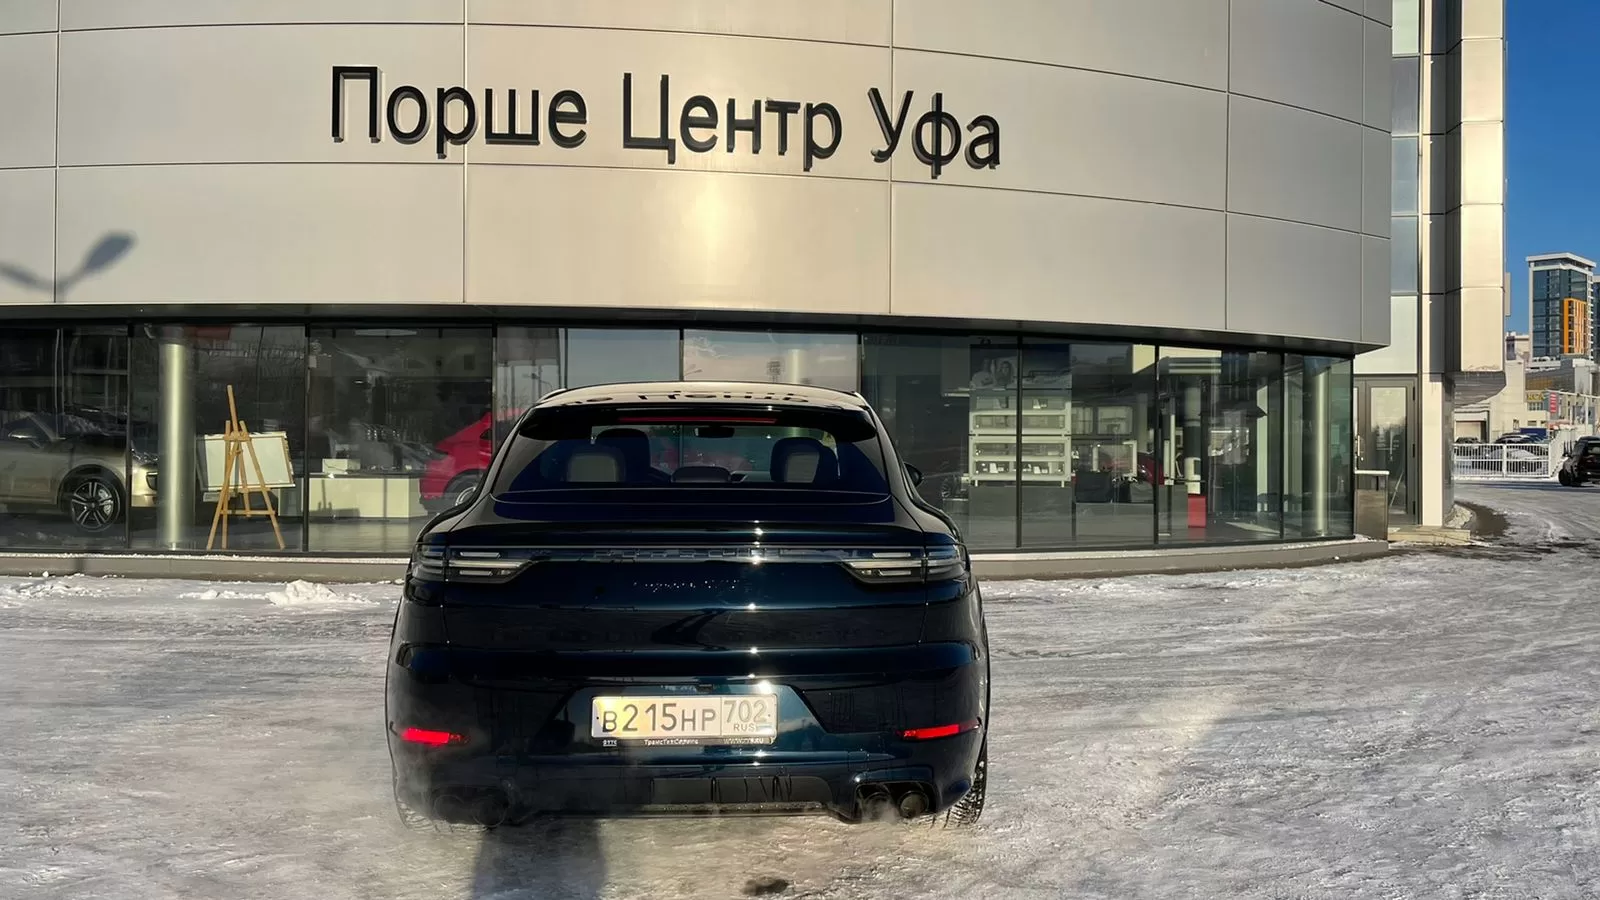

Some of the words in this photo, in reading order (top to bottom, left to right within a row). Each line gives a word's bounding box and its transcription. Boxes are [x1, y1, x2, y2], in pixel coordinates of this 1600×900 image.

[331, 65, 588, 159] Порше
[622, 72, 843, 173] Центр
[868, 86, 1002, 180] Уфа
[724, 700, 767, 723] 702
[733, 723, 754, 732] RUS
